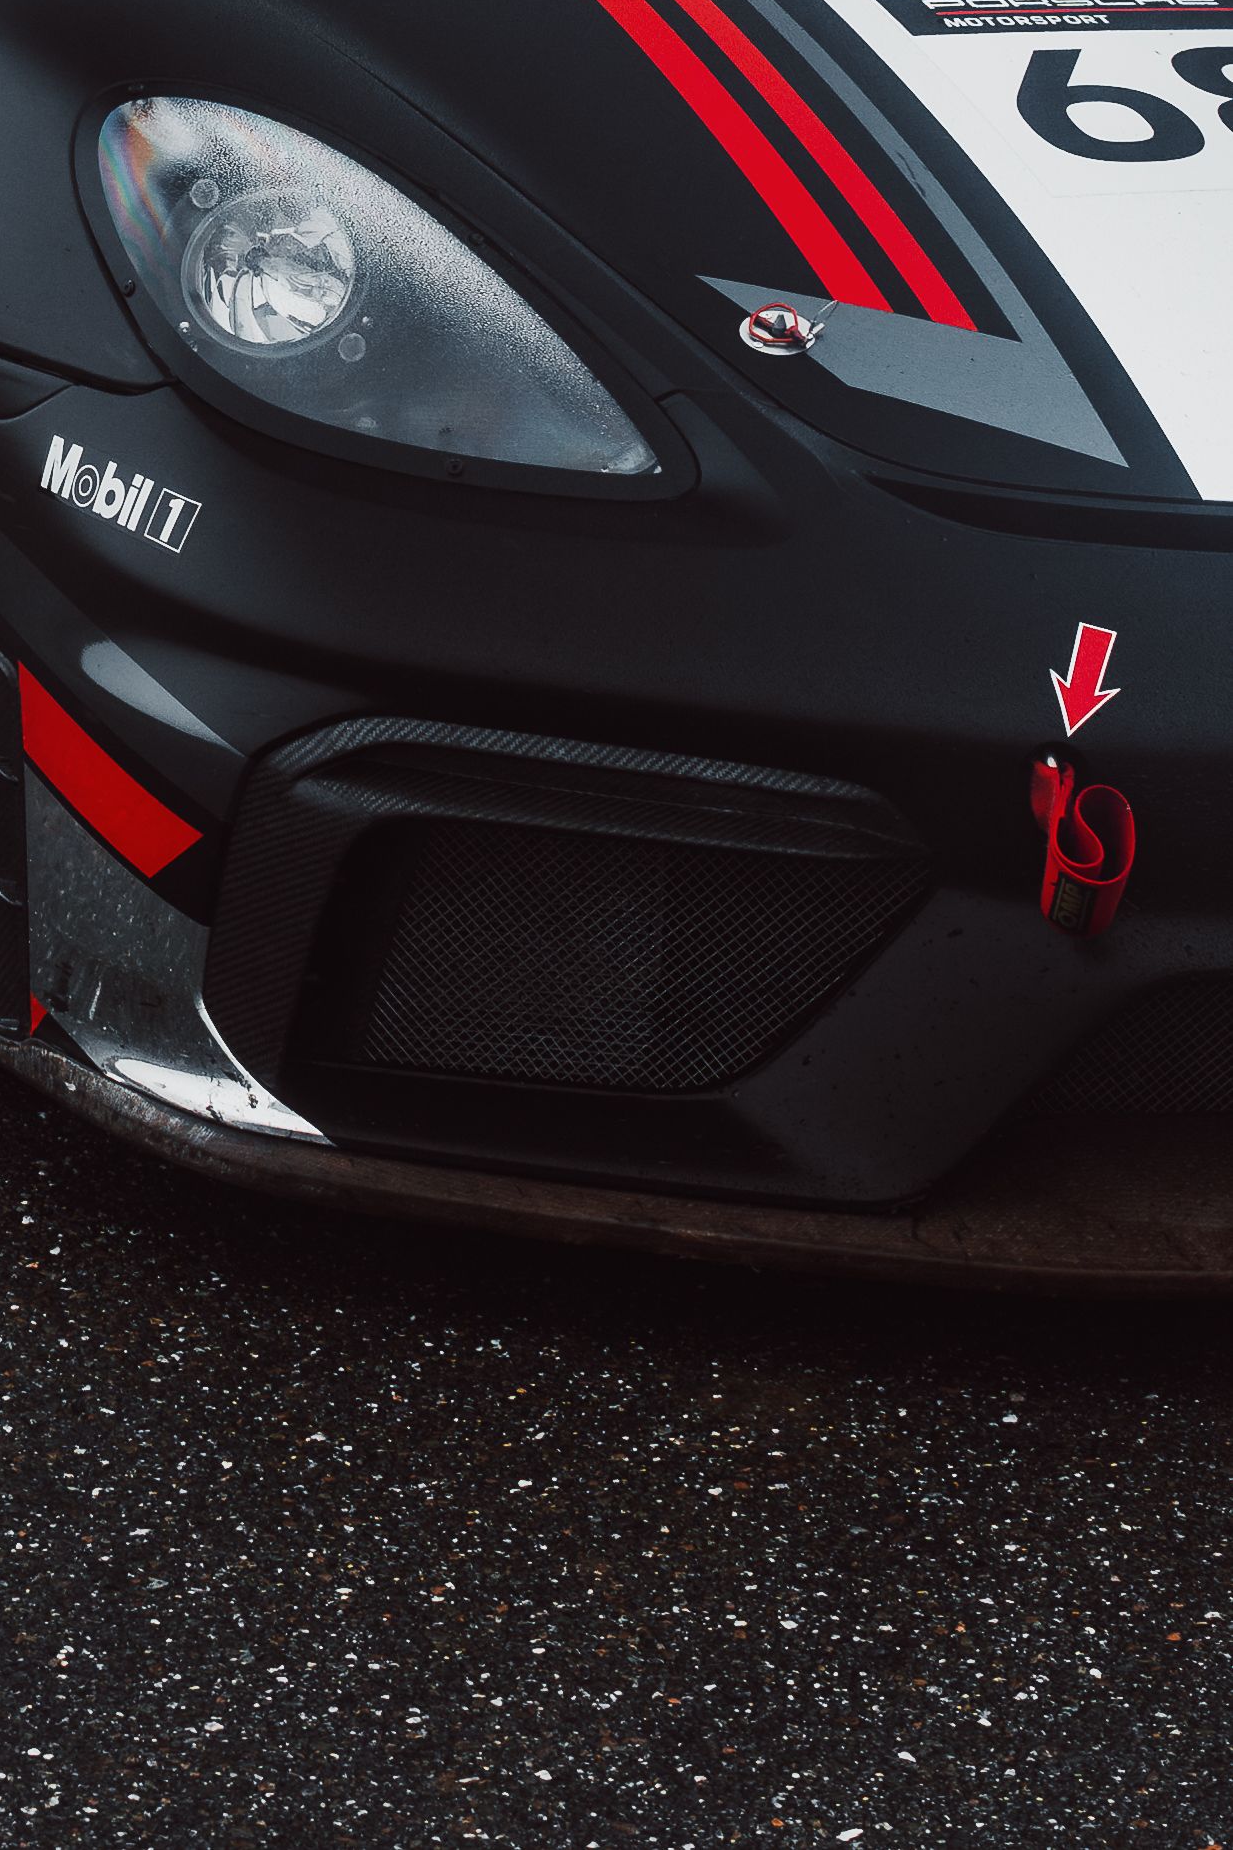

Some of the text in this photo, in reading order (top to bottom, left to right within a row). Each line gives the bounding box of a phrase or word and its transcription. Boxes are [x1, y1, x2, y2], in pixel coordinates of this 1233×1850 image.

[943, 14, 1111, 28] MOTORSPORT
[40, 434, 186, 543] Mobil 1
